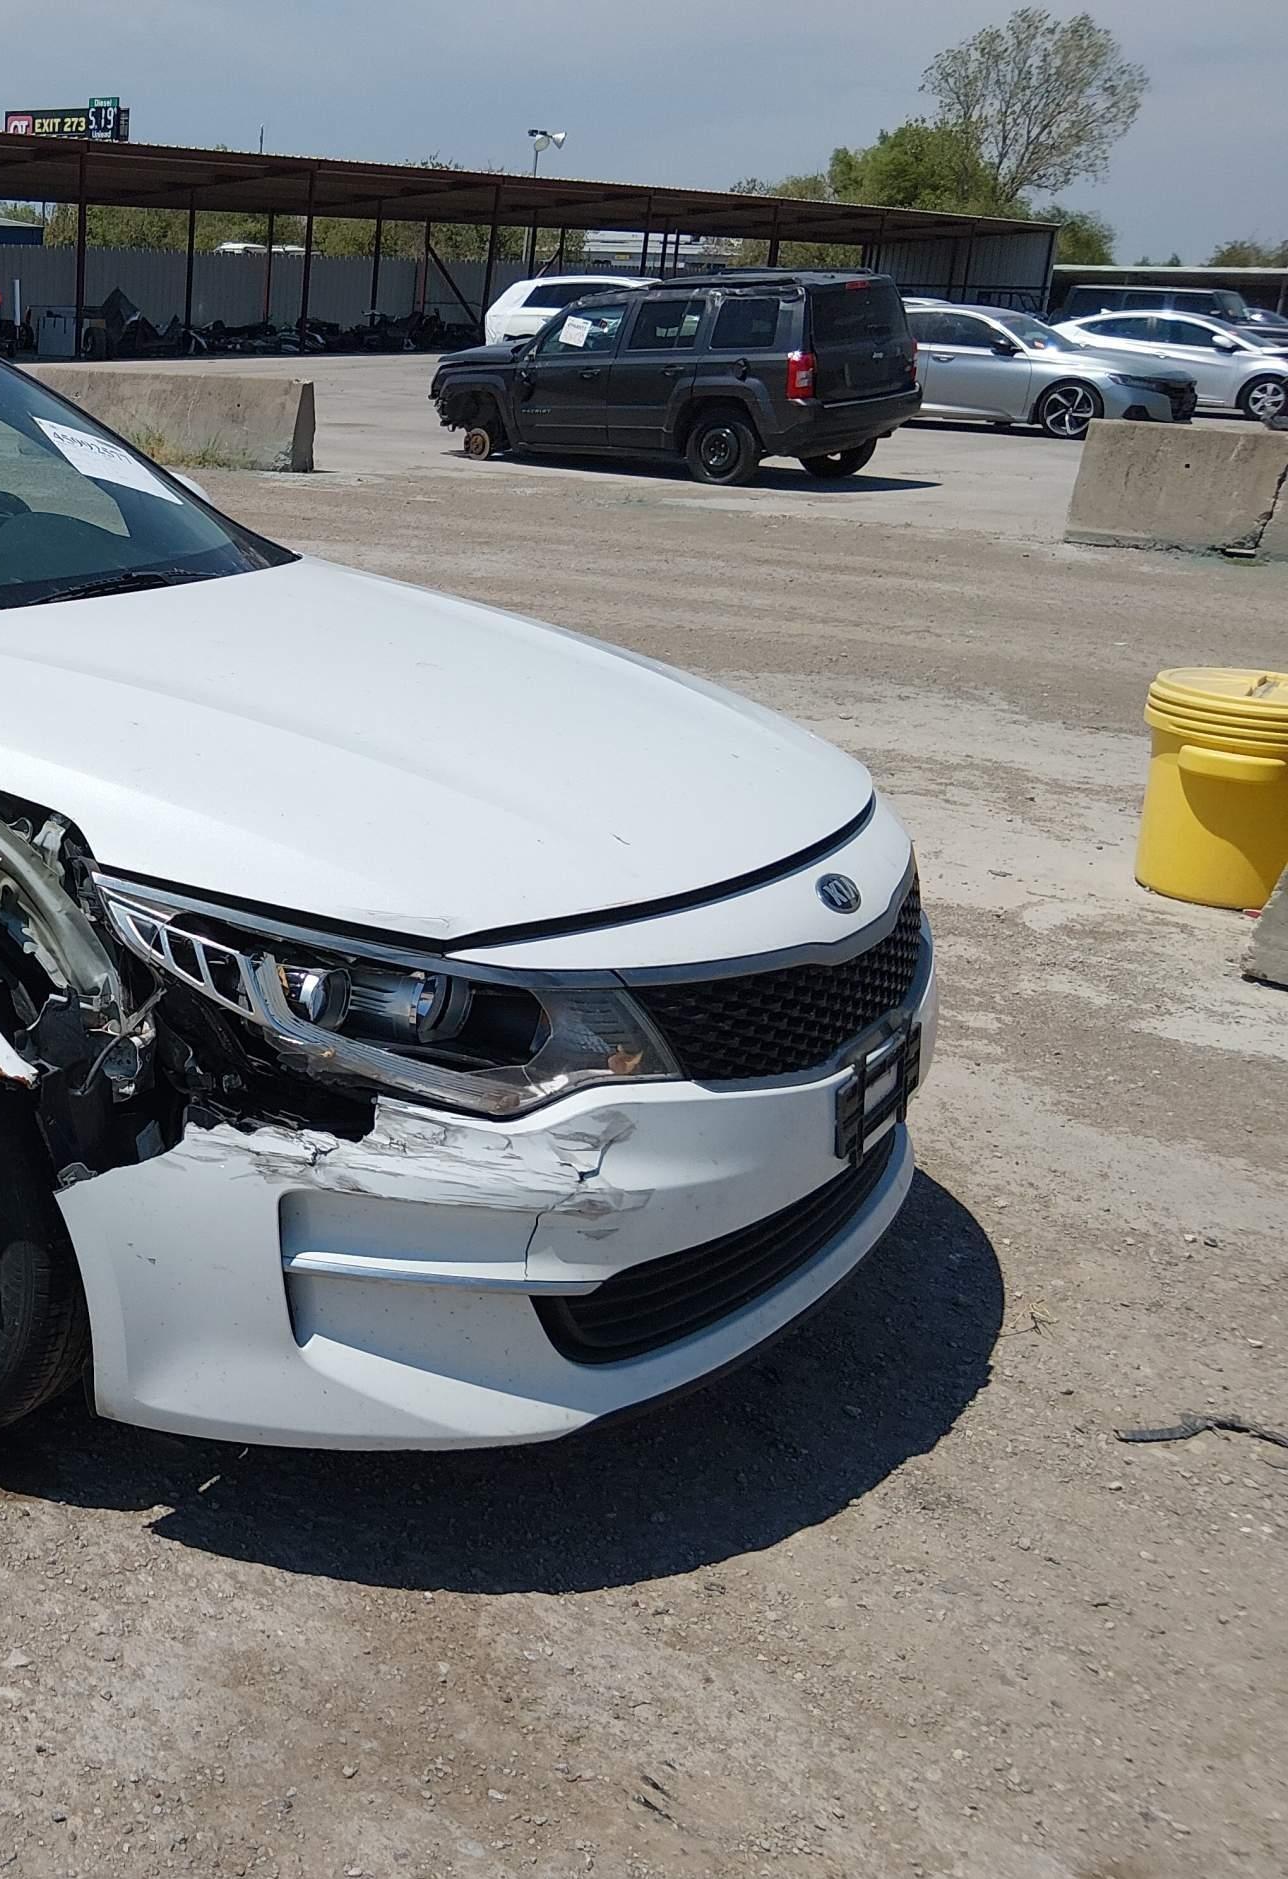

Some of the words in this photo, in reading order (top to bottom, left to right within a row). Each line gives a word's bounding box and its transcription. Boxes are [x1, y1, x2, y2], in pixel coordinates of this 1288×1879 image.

[95, 99, 112, 107] Diesel
[34, 118, 61, 133] EXIT
[63, 117, 86, 132] 273
